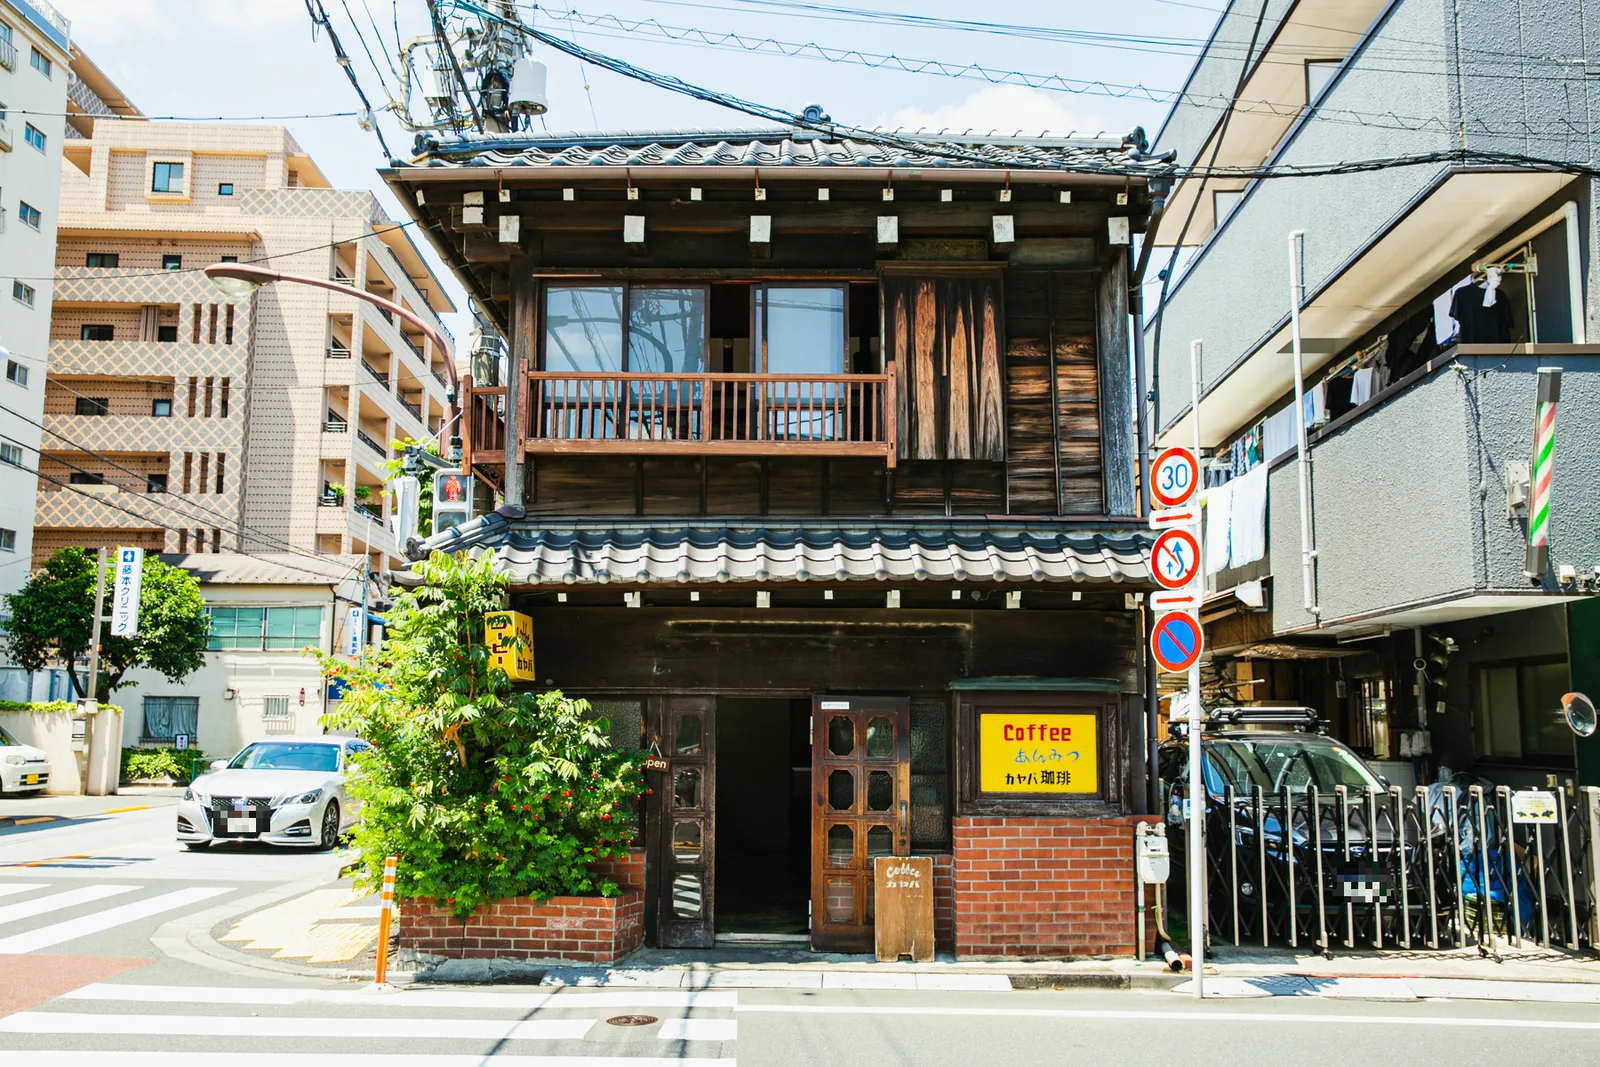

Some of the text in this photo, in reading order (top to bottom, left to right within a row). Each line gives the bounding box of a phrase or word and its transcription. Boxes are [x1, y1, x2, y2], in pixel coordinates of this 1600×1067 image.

[1162, 464, 1187, 490] 30
[117, 565, 132, 632] 藤本クリニック
[517, 656, 533, 672] カヤバ
[1003, 724, 1071, 742] Coffee
[1014, 748, 1079, 763] あんみつ
[1005, 770, 1071, 785] カヤバ珈琲
[886, 862, 921, 878] Coffee
